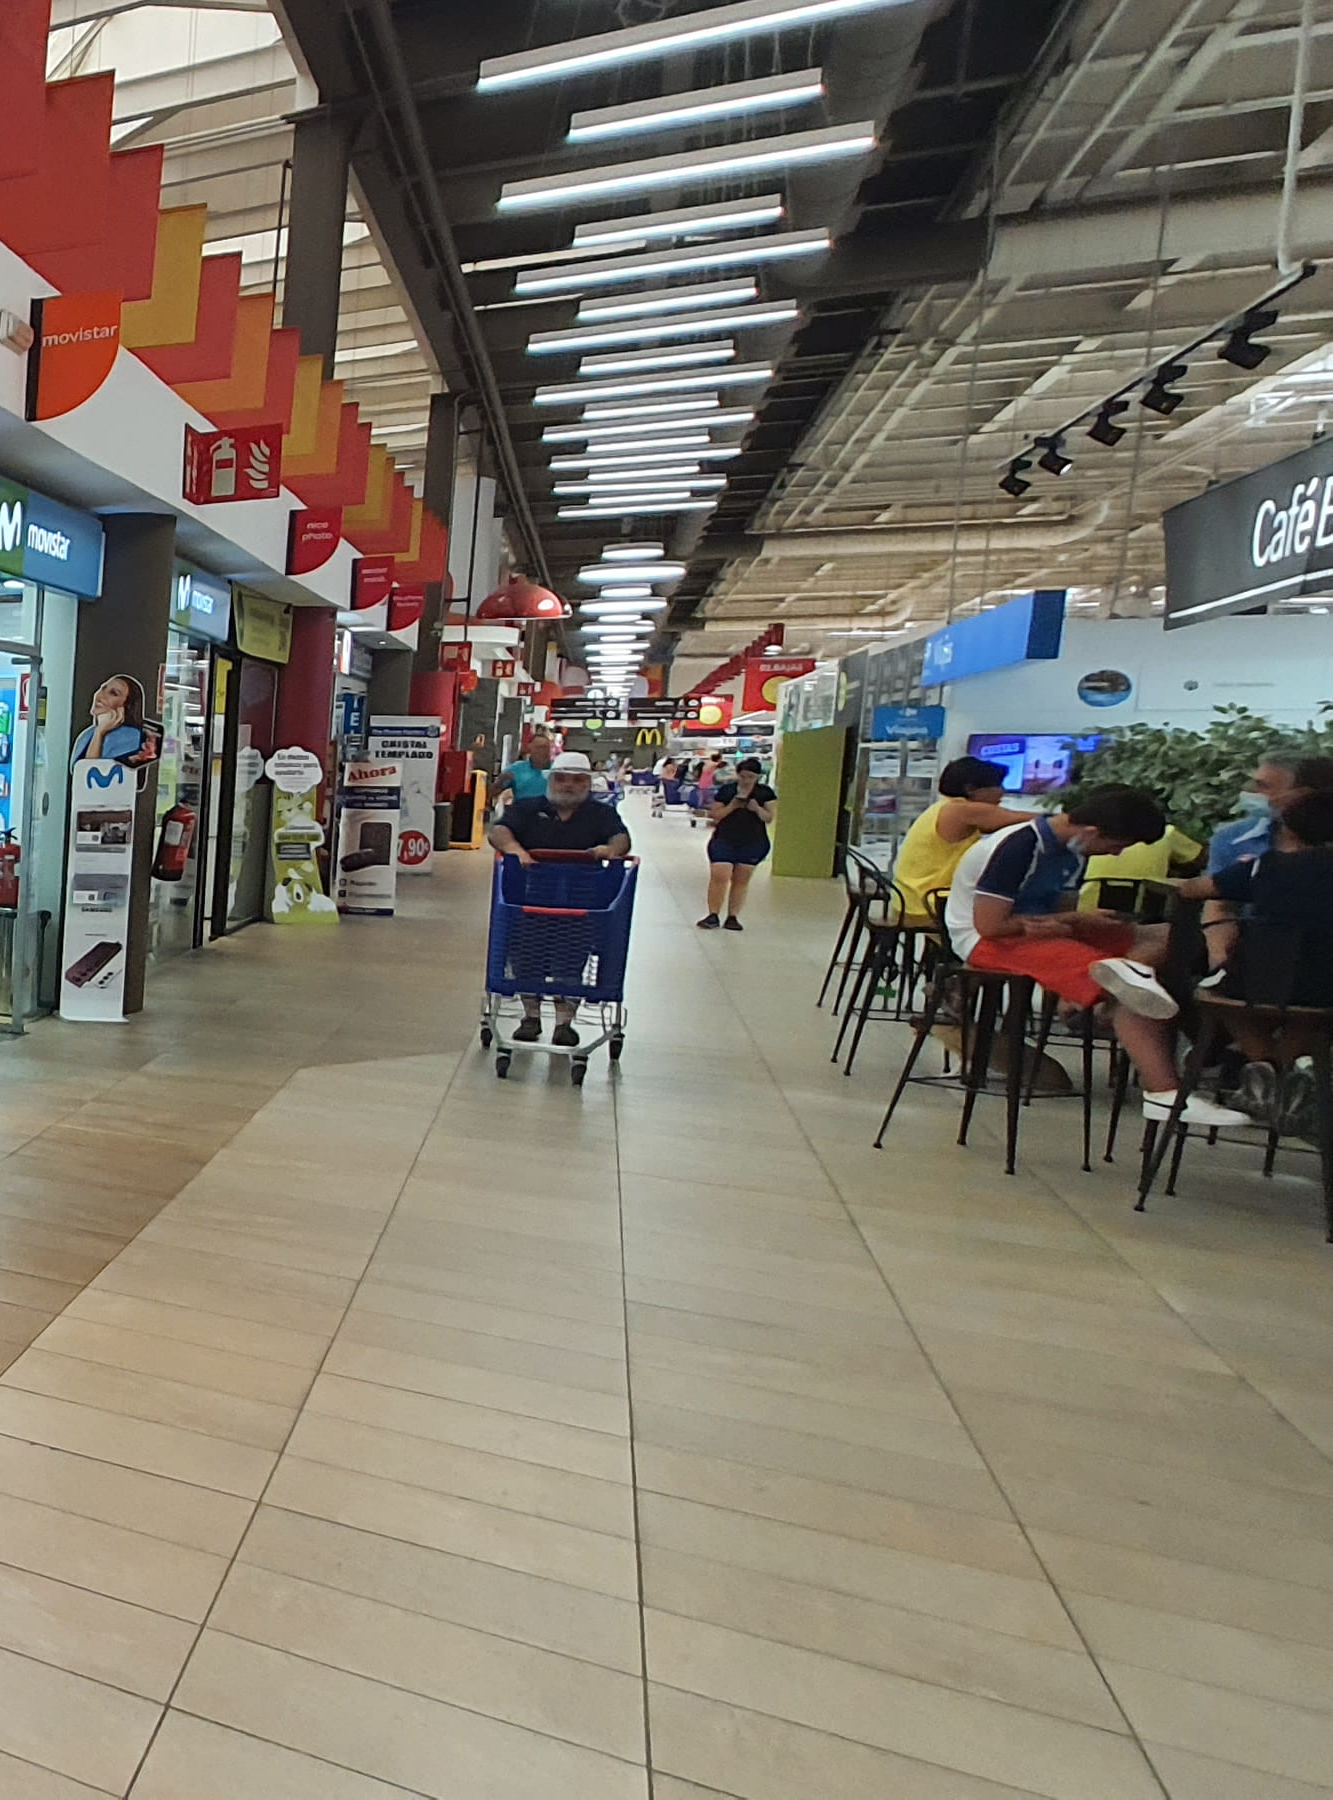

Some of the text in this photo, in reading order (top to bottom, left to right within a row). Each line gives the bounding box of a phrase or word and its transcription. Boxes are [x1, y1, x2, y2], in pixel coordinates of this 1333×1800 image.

[42, 324, 118, 348] movistar
[1253, 477, 1319, 567] Café
[28, 523, 71, 560] movistar
[302, 532, 333, 542] photo
[348, 765, 397, 781] Ahora
